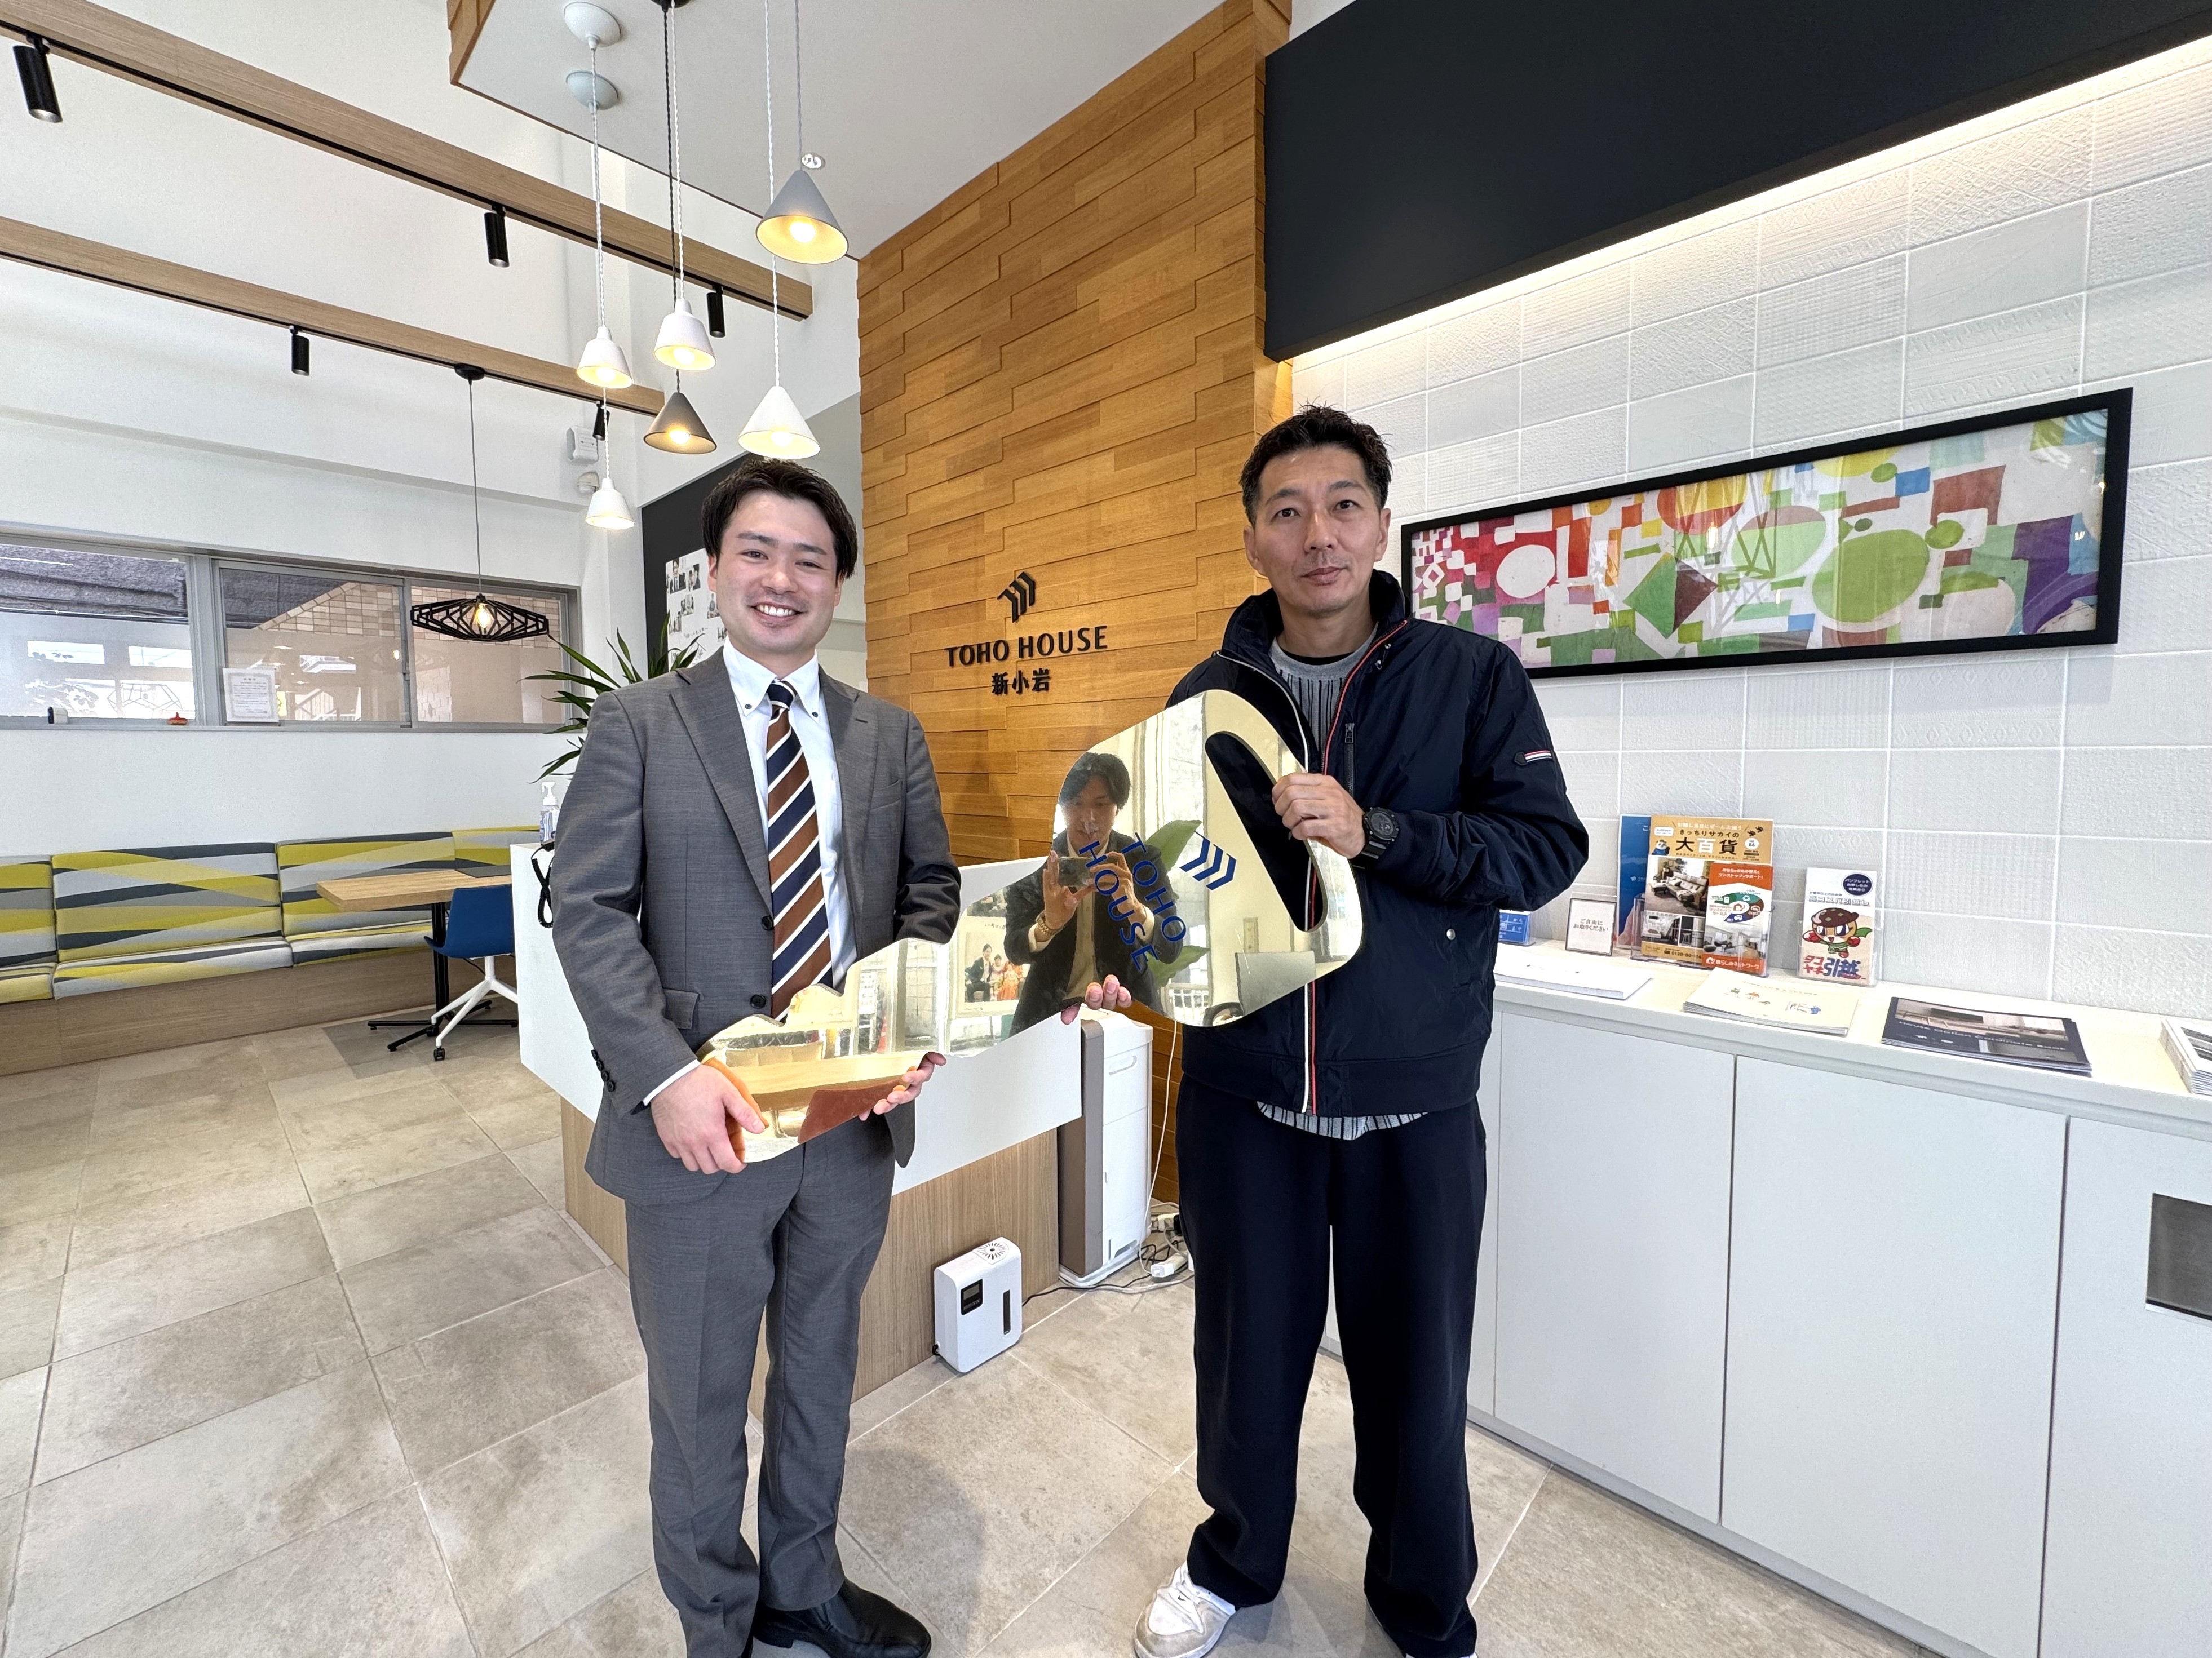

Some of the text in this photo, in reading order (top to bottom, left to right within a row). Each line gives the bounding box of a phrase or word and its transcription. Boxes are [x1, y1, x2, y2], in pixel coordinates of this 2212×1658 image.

[945, 625, 1108, 667] TOHO HOUSE
[991, 668, 1051, 696] 新小岩
[1679, 828, 1740, 838] きっちりサカイの
[1675, 836, 1738, 855] 大百貨
[1120, 832, 1187, 943] TOHO
[1078, 840, 1160, 971] HOUSE
[1573, 923, 1609, 932] お取りください
[1803, 964, 1824, 975] ヤキ
[1804, 954, 1825, 966] タコ
